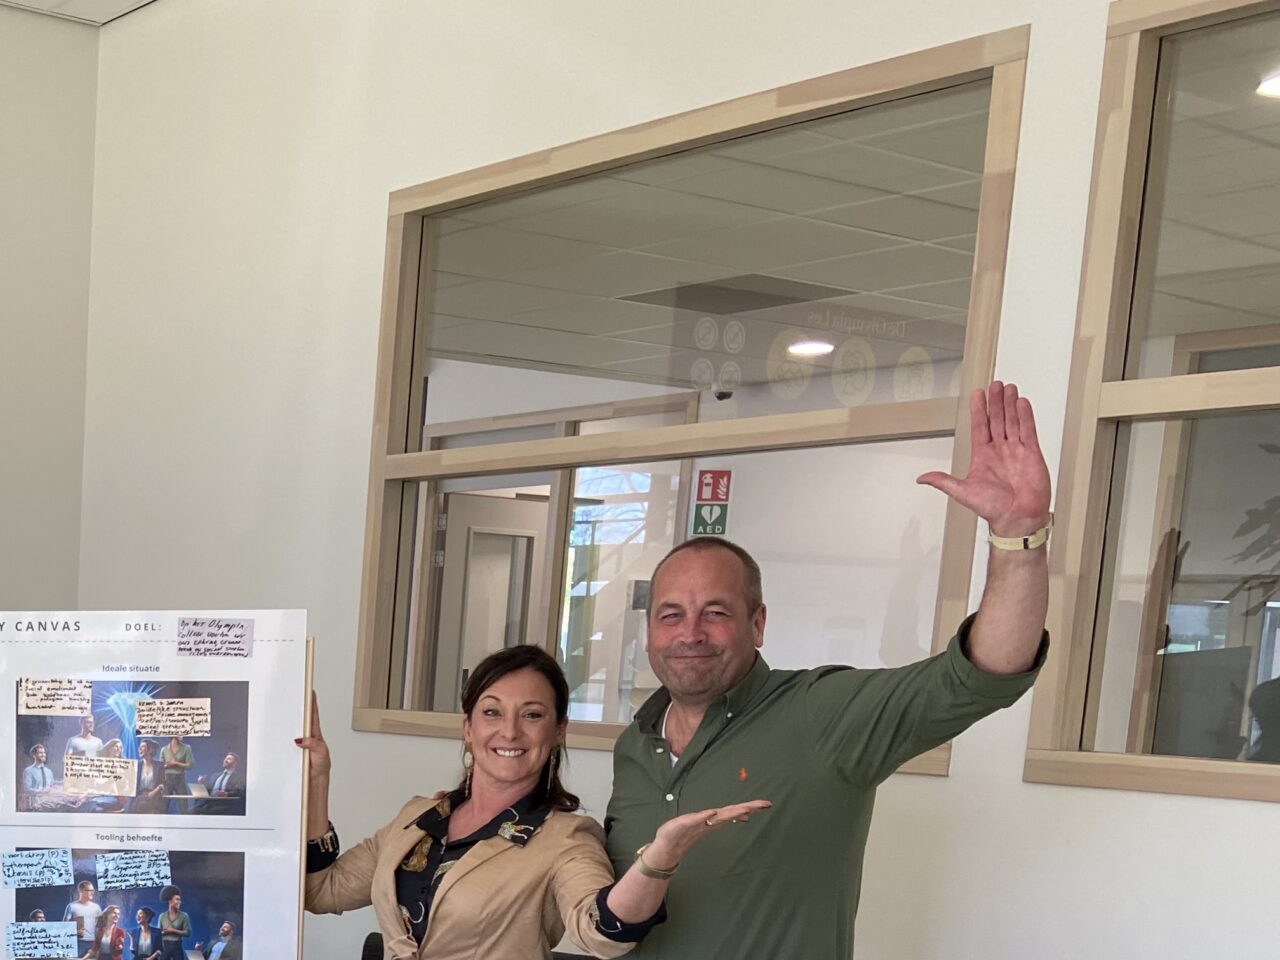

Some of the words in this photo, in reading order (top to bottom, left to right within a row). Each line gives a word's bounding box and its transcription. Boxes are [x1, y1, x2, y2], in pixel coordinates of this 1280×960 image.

[697, 525, 722, 534] AED
[15, 620, 81, 632] CANVAS
[125, 623, 162, 631] DOEL:
[102, 664, 127, 672] Ideale
[129, 664, 160, 672] situatie
[95, 833, 125, 842] Tooling
[126, 833, 163, 841] behoefte
